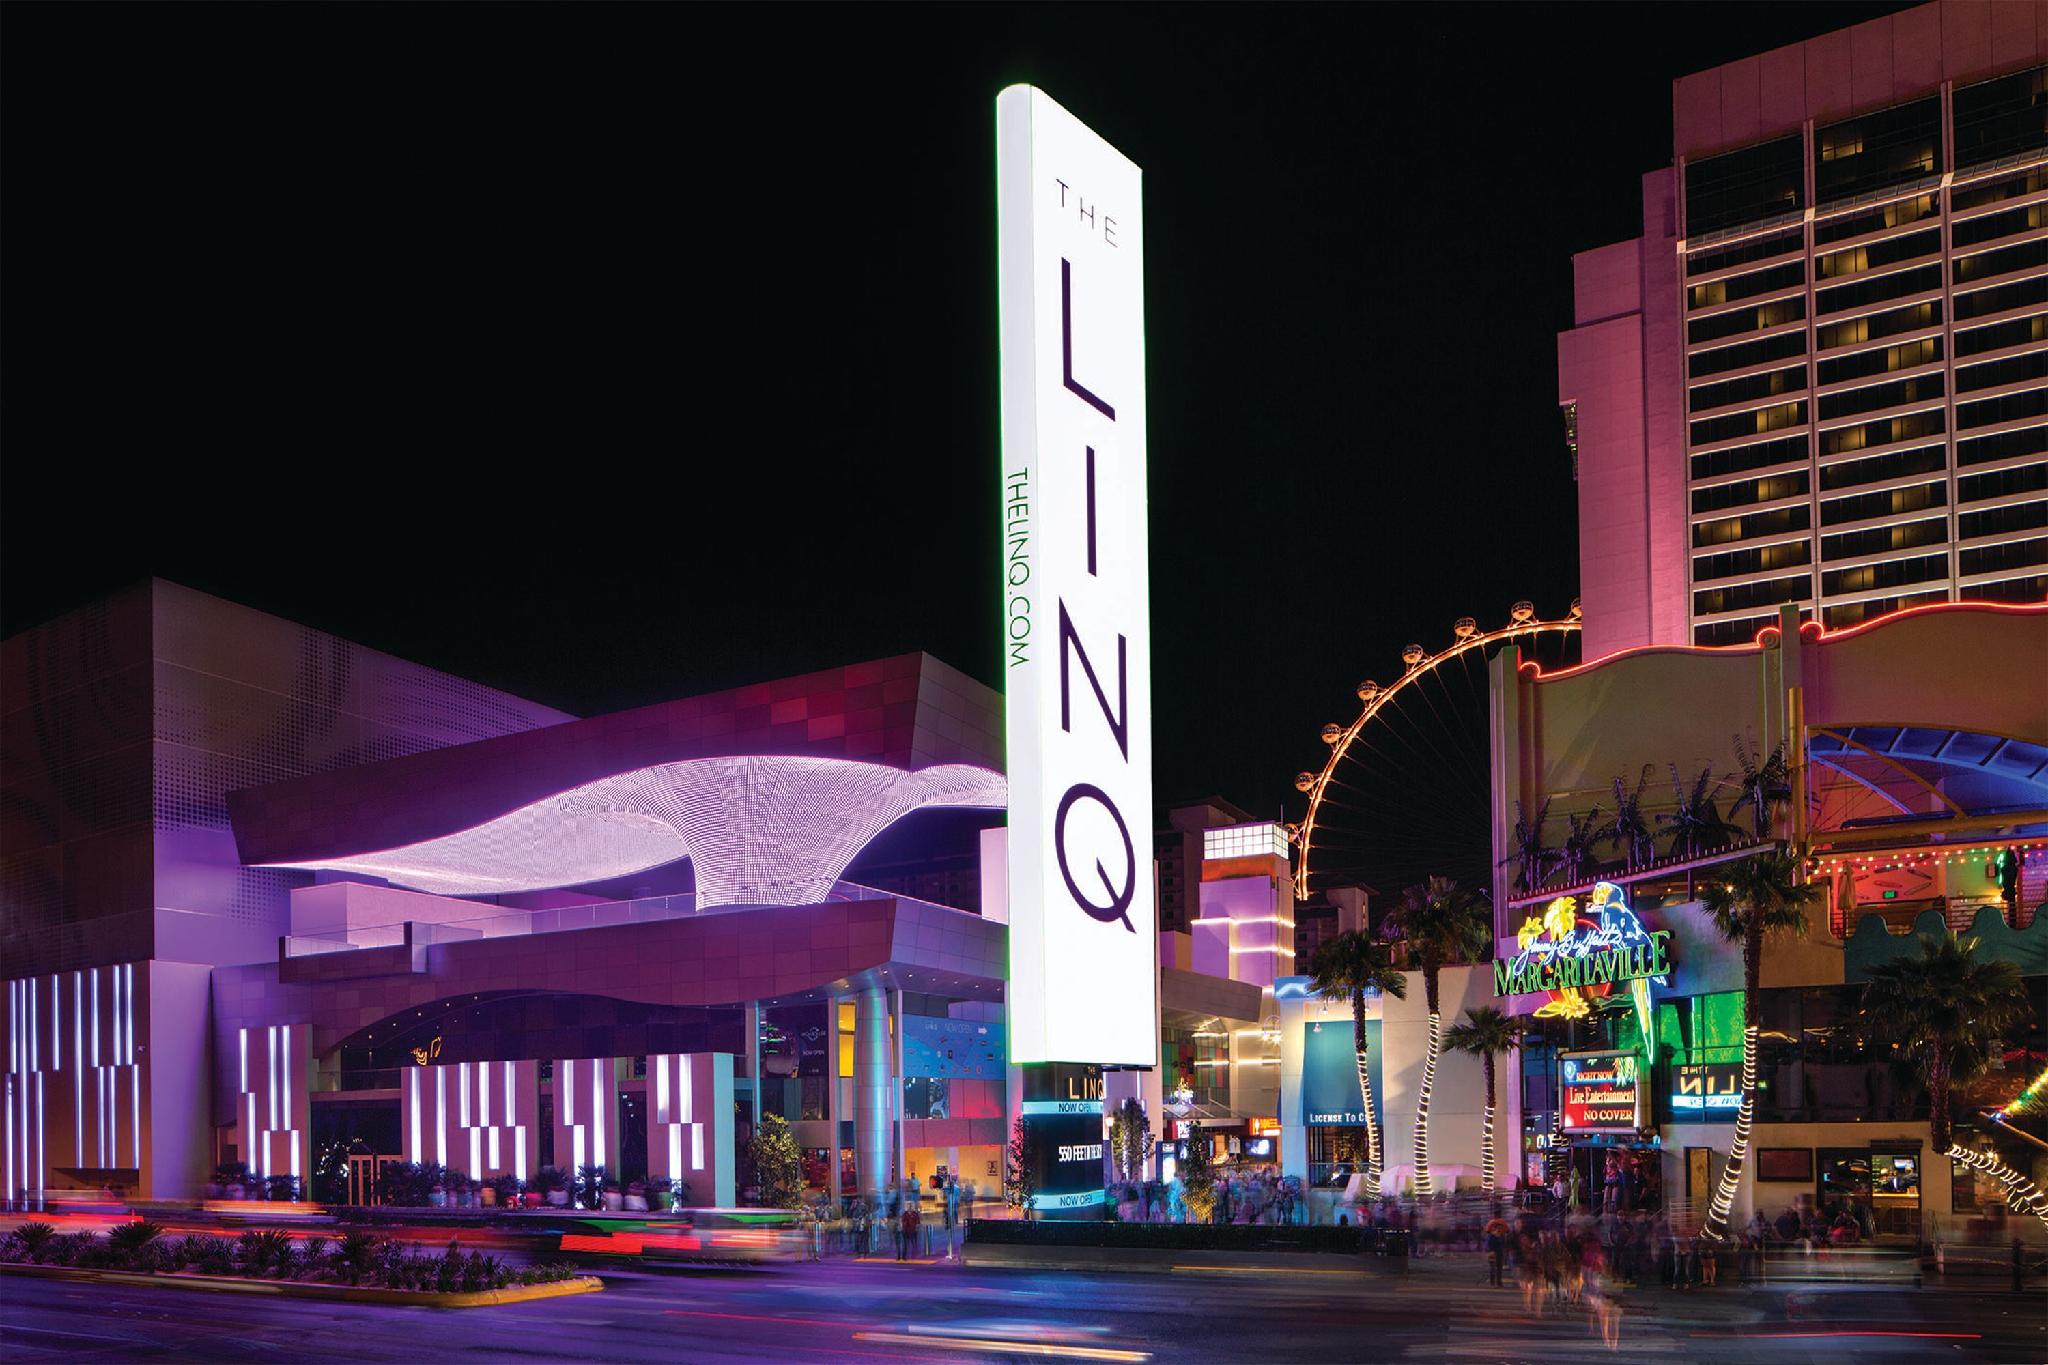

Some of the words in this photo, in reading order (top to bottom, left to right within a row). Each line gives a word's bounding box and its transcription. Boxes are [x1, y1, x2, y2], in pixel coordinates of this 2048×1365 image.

[1056, 178, 1118, 248] THE
[1007, 467, 1031, 668] THELINQ.COM
[1055, 256, 1137, 934] LINQ
[1492, 930, 1671, 997] MARGARITAVILLE
[1576, 1071, 1596, 1081] RIGHT
[1596, 1071, 1614, 1081] NOW
[1069, 1077, 1104, 1101] LINQ
[1569, 1086, 1585, 1104] Live
[1584, 1086, 1635, 1104] Entertainment
[1058, 1102, 1077, 1112] NOW
[1583, 1110, 1598, 1121] NO
[1599, 1108, 1634, 1121] COVER
[1058, 1145, 1072, 1162] 550
[1060, 1195, 1079, 1206] NOW
